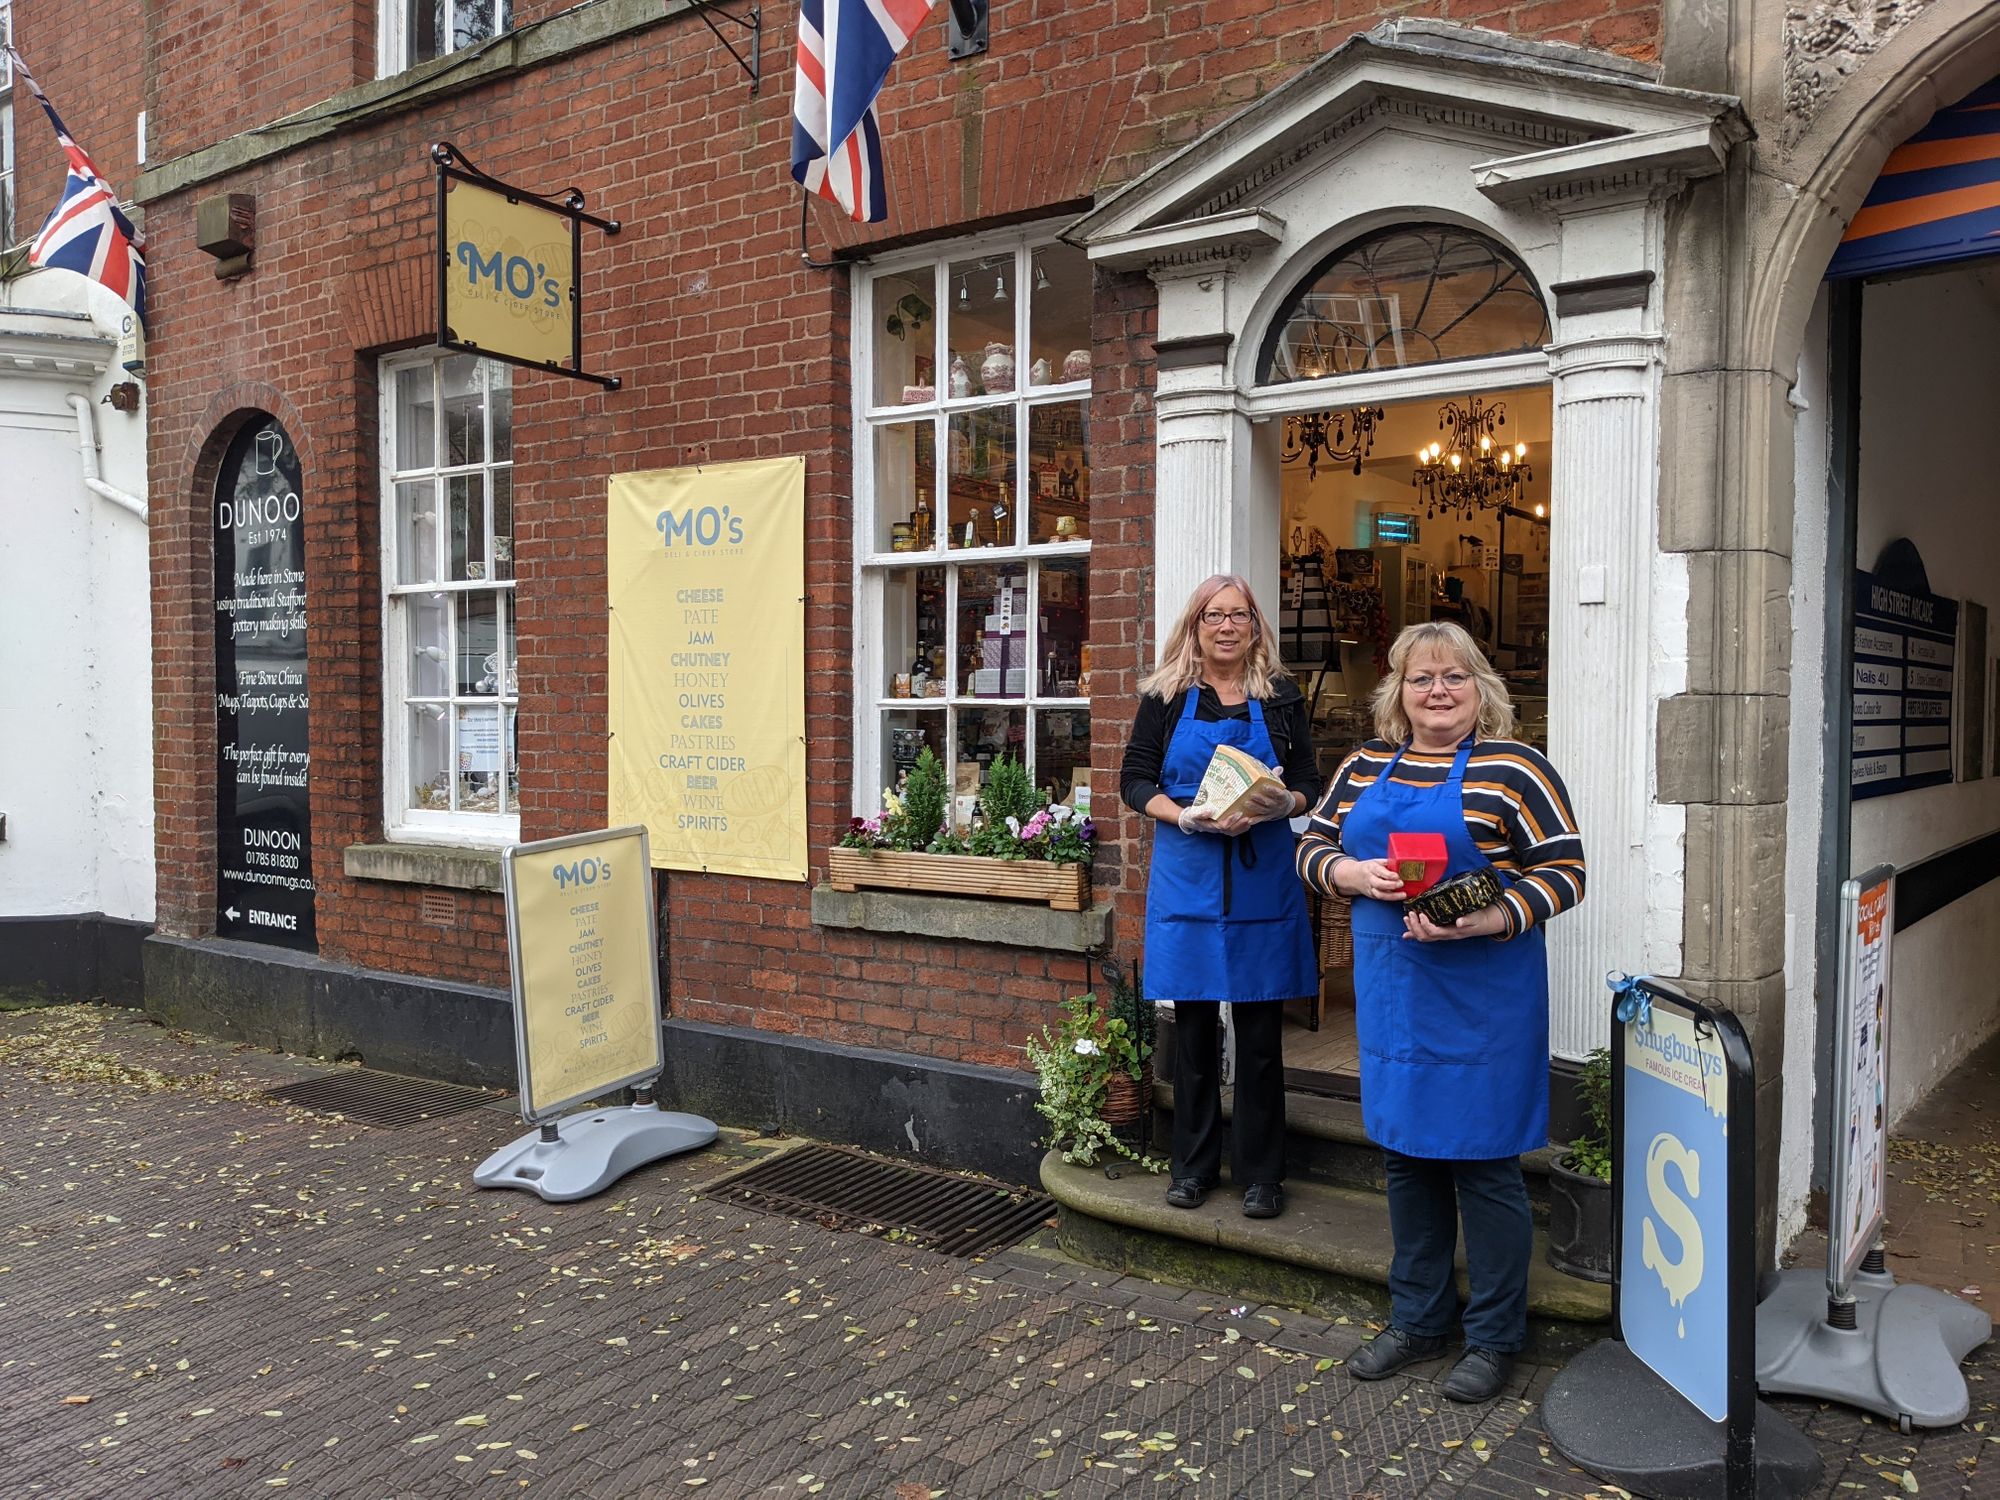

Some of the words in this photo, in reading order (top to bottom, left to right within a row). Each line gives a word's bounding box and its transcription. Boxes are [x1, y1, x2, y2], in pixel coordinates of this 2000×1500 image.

[456, 241, 560, 307] MO's
[534, 306, 561, 319] STORE
[656, 505, 744, 547] MO's
[248, 531, 261, 544] Est
[265, 528, 287, 543] 1974
[234, 567, 257, 587] Made
[257, 567, 273, 585] here
[274, 569, 282, 584] in
[283, 568, 305, 583] Stone
[216, 596, 236, 617] using
[237, 589, 278, 609] traditional
[676, 588, 724, 604] CHEESE
[1871, 585, 1888, 613] HIGH
[1888, 590, 1911, 618] STREET
[1911, 597, 1934, 624] ARCADE
[230, 620, 259, 640] pottery
[260, 612, 289, 638] making
[289, 611, 308, 630] skills
[683, 609, 719, 625] PATE
[687, 631, 714, 645] JAM
[671, 652, 730, 667] CHUTNEY
[239, 670, 257, 685] Fine
[257, 670, 277, 685] Bone
[278, 666, 302, 685] China
[673, 672, 729, 688] HONEY
[1856, 668, 1876, 684] Nails
[1878, 671, 1889, 686] 4U
[218, 693, 240, 715] Mugs,
[269, 693, 288, 716] Cups
[288, 693, 299, 708] &
[678, 693, 725, 708] OLIVES
[680, 714, 723, 730] CAKES
[670, 734, 736, 751] PASTRIES
[223, 742, 239, 760] The
[237, 743, 264, 768] perfect
[262, 744, 277, 769] gift
[275, 744, 289, 770] for
[289, 752, 310, 770] every
[659, 754, 703, 770] CRAFT
[706, 756, 746, 772] CIDER
[236, 772, 251, 783] can
[251, 766, 260, 784] be
[258, 767, 285, 791] found
[284, 769, 307, 787] inside!
[686, 774, 718, 790] BEER
[683, 794, 724, 811] WINE
[678, 814, 728, 832] SPIRITS
[244, 828, 300, 850] DUNOON
[246, 850, 270, 866] 01785
[270, 853, 299, 870] 818300
[552, 856, 612, 890] MO's
[569, 901, 600, 916] CHEESE
[249, 909, 297, 931] ENTRANCE
[575, 915, 598, 928] PATE
[578, 928, 596, 940] JAM
[569, 938, 605, 954] CHUTNEY
[571, 950, 604, 967] HONEY
[575, 962, 602, 977] OLIVES
[577, 975, 602, 989] CAKES
[571, 984, 609, 1003] PASTRIES
[564, 1001, 591, 1017] CRAFT
[592, 994, 615, 1009] CIDER
[580, 1032, 608, 1049] SPIRITS
[1634, 1024, 1723, 1077] Snugburys
[1645, 1058, 1671, 1078] FAMOUS
[1672, 1069, 1683, 1083] ICE
[1683, 1074, 1708, 1094] CREAM
